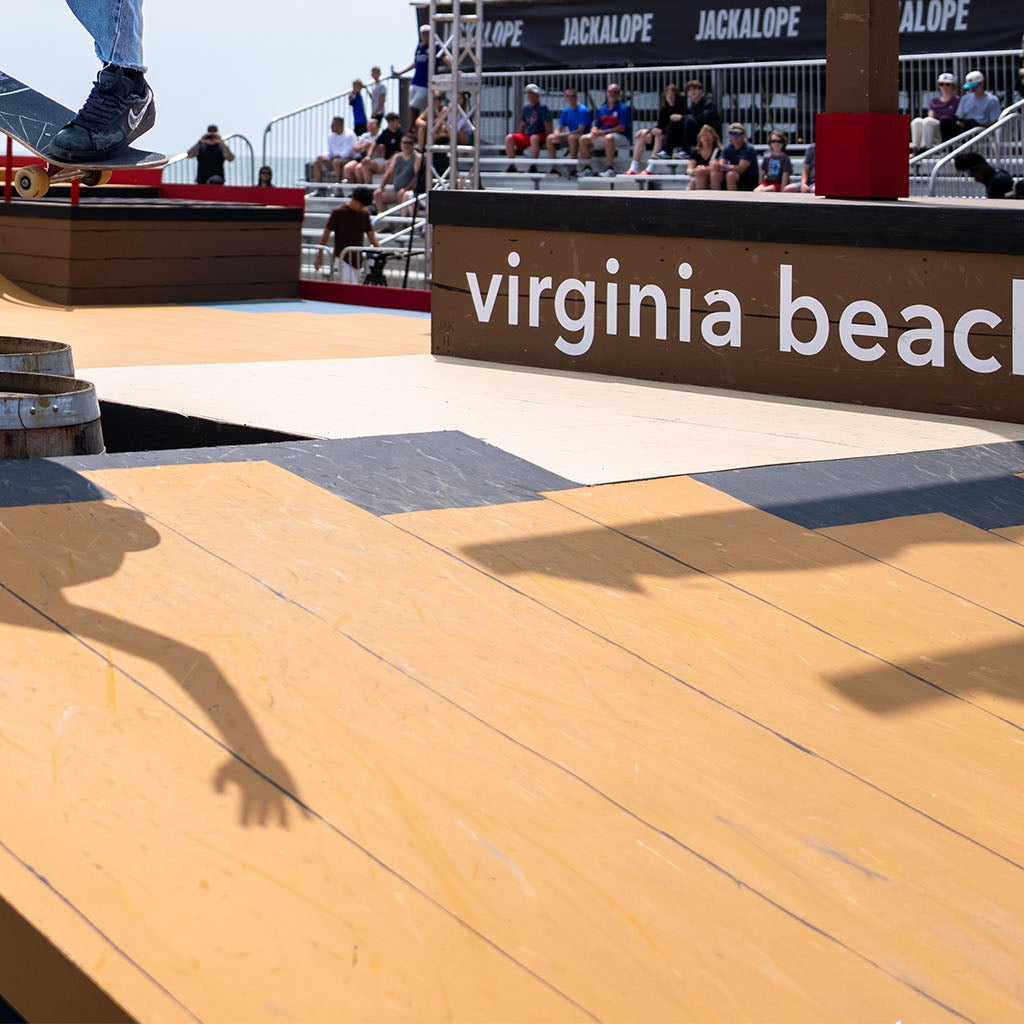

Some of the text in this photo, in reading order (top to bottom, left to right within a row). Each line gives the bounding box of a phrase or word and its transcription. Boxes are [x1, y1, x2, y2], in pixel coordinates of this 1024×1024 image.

[560, 13, 654, 46] JACKALOPE
[695, 6, 801, 41] JACKALOPE
[465, 251, 743, 356] virginia
